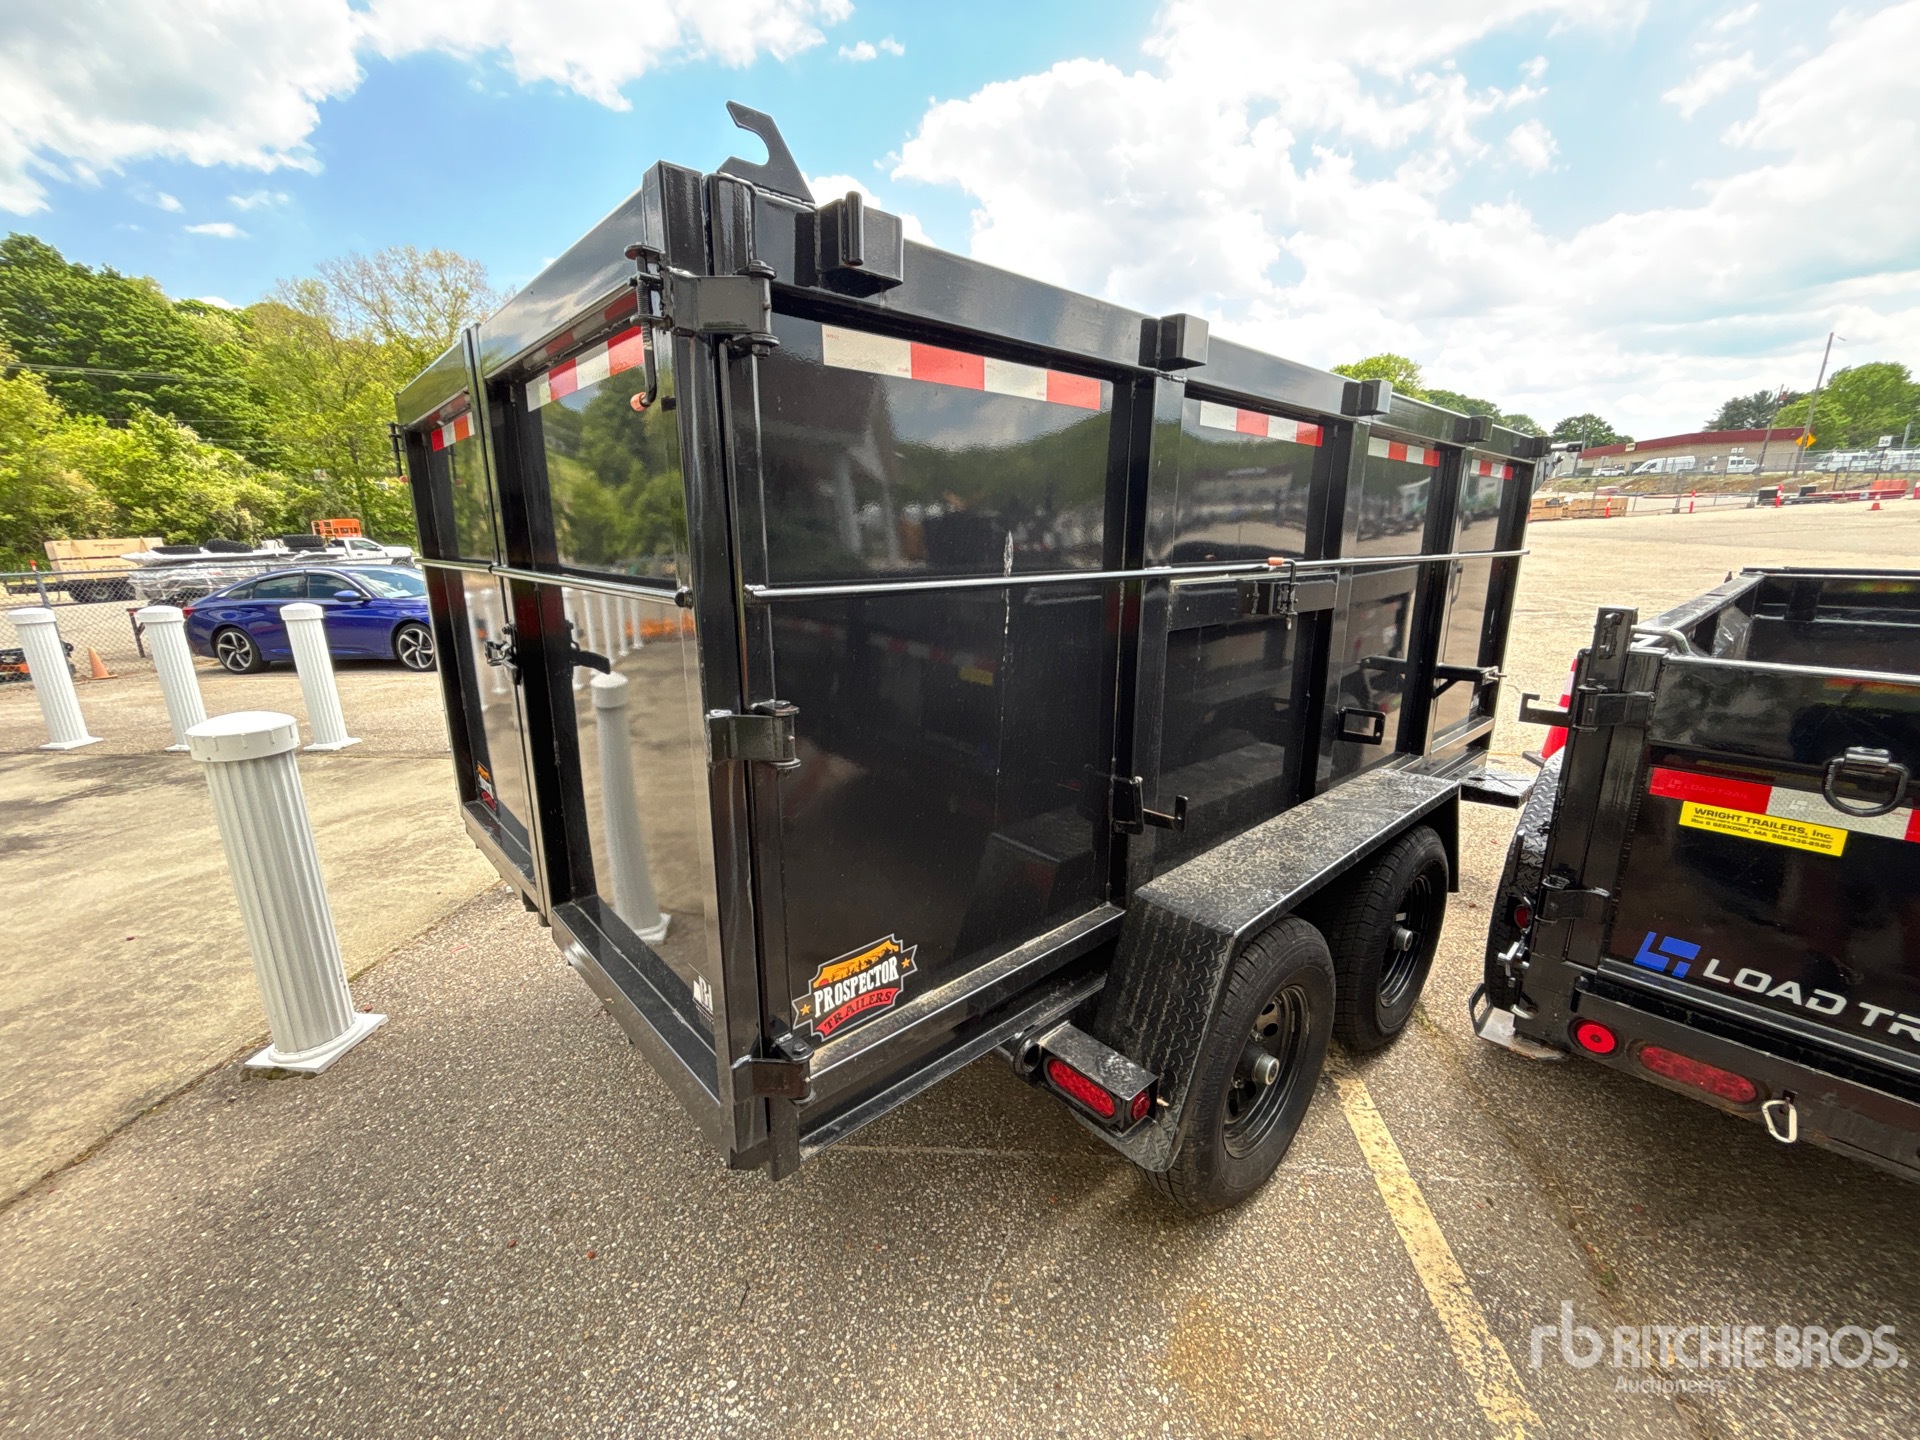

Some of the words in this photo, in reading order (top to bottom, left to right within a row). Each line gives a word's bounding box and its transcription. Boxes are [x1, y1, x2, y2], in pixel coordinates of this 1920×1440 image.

[1694, 807, 1742, 822] WRIGHT
[1745, 816, 1808, 836] TRAILERS,
[1812, 829, 1834, 840] Inc.
[1754, 829, 1768, 837] MA
[814, 955, 899, 1018] PROSPECTOR
[1702, 958, 1848, 1016] LOAD
[824, 990, 892, 1030] TRAILERS
